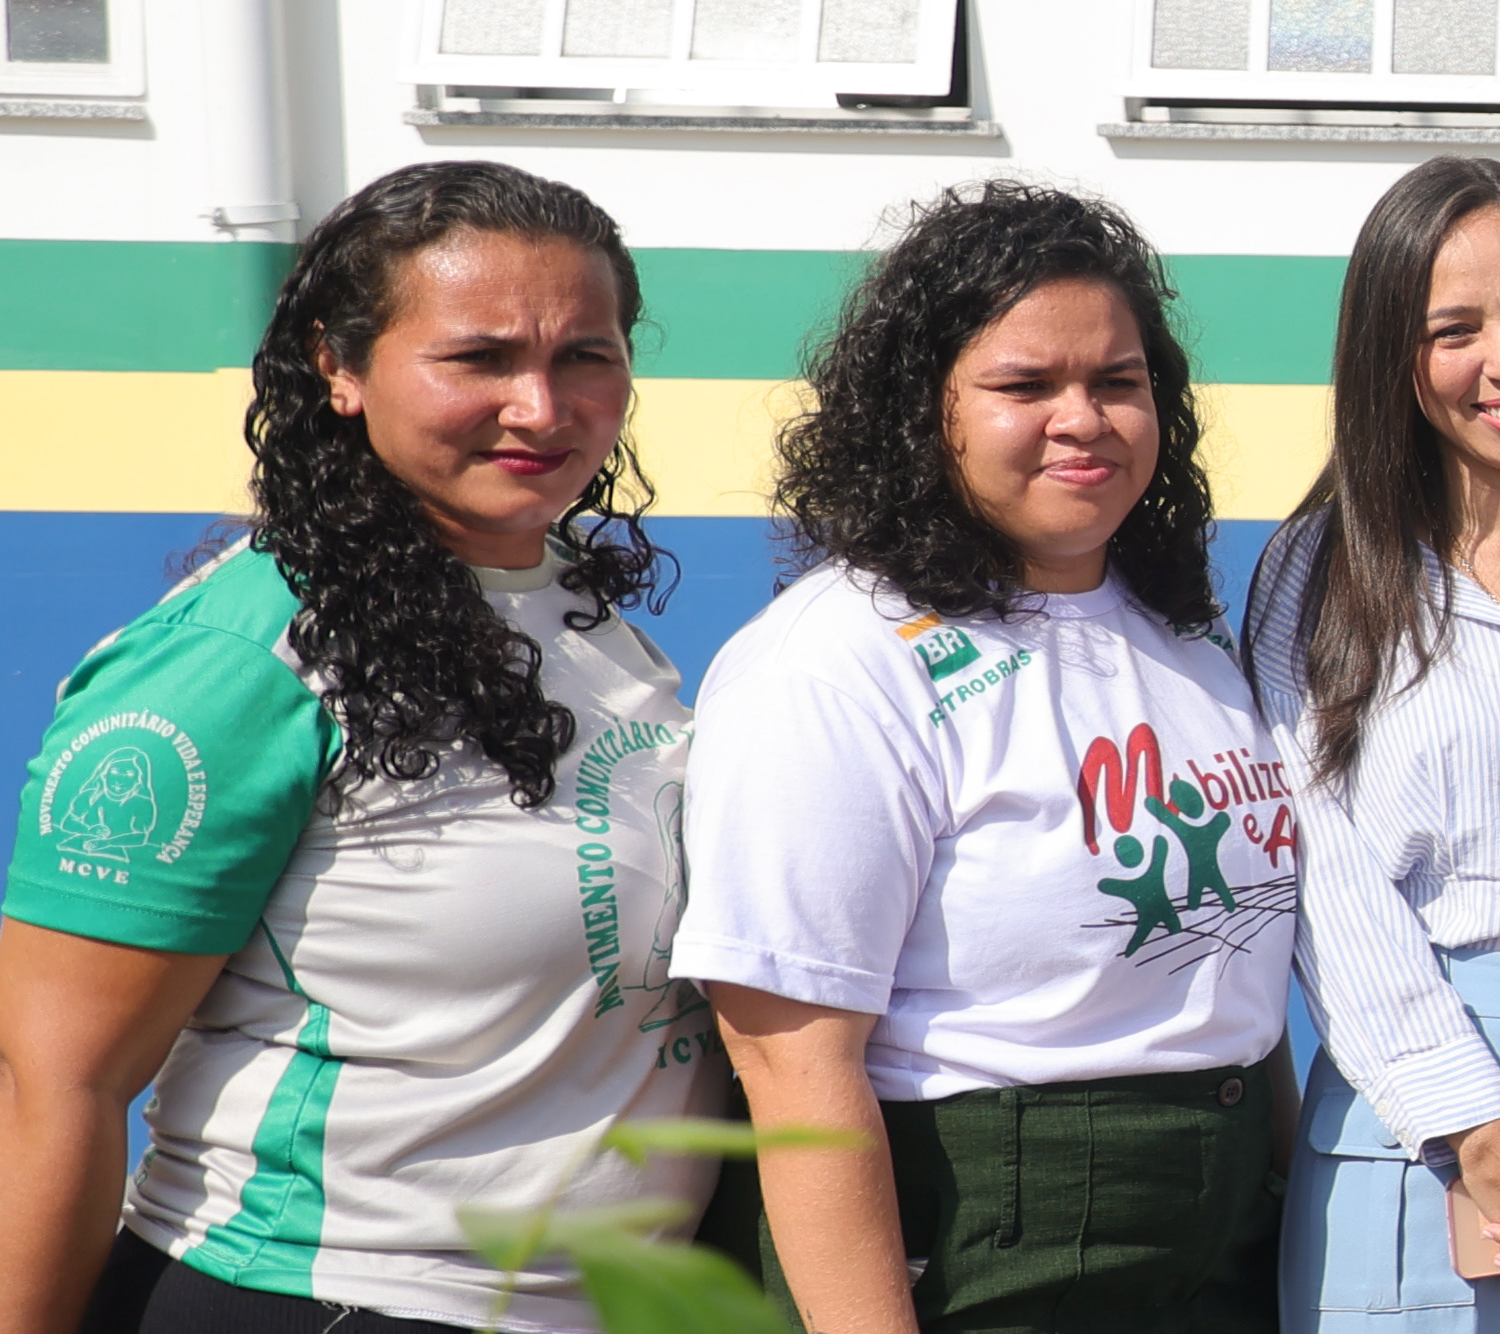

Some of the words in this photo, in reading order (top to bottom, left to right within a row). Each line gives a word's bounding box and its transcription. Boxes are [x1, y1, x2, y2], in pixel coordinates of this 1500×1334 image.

[922, 626, 966, 666] BR
[928, 649, 1032, 729] PTROBRAS
[70, 708, 178, 753] COMUNITÁRIO
[172, 731, 203, 771] VIDA
[38, 750, 74, 836] MOVIMENTO
[187, 770, 207, 781] E
[576, 717, 678, 836] COMUNITÁRIO
[155, 783, 208, 865] ESPERANÇA
[1243, 813, 1264, 845] e
[58, 858, 130, 884] MCVE
